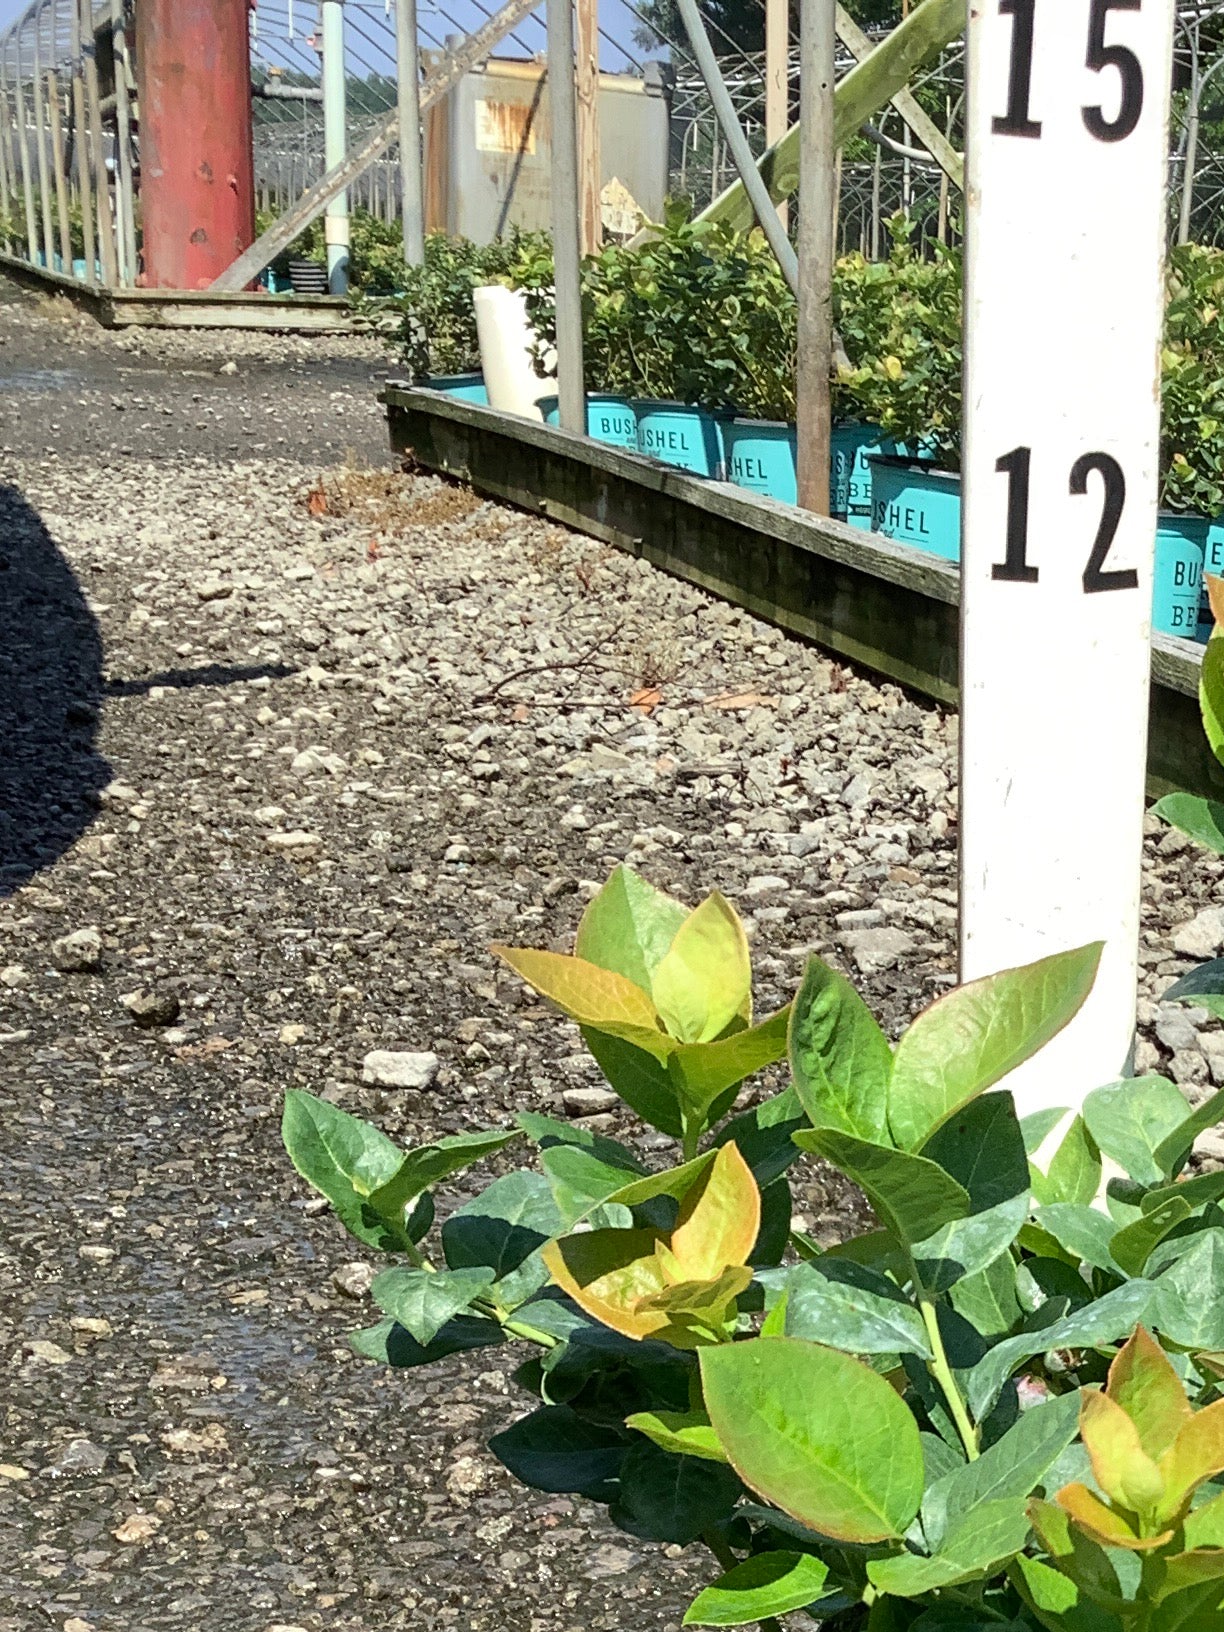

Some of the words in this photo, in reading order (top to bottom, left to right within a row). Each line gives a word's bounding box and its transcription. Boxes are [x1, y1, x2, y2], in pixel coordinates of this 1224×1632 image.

[991, 0, 1145, 143] 15
[601, 417, 638, 434] BUS
[640, 428, 689, 450] USHEL
[727, 455, 767, 480] SHEL
[873, 498, 929, 534] SHEL
[991, 446, 1139, 594] 12
